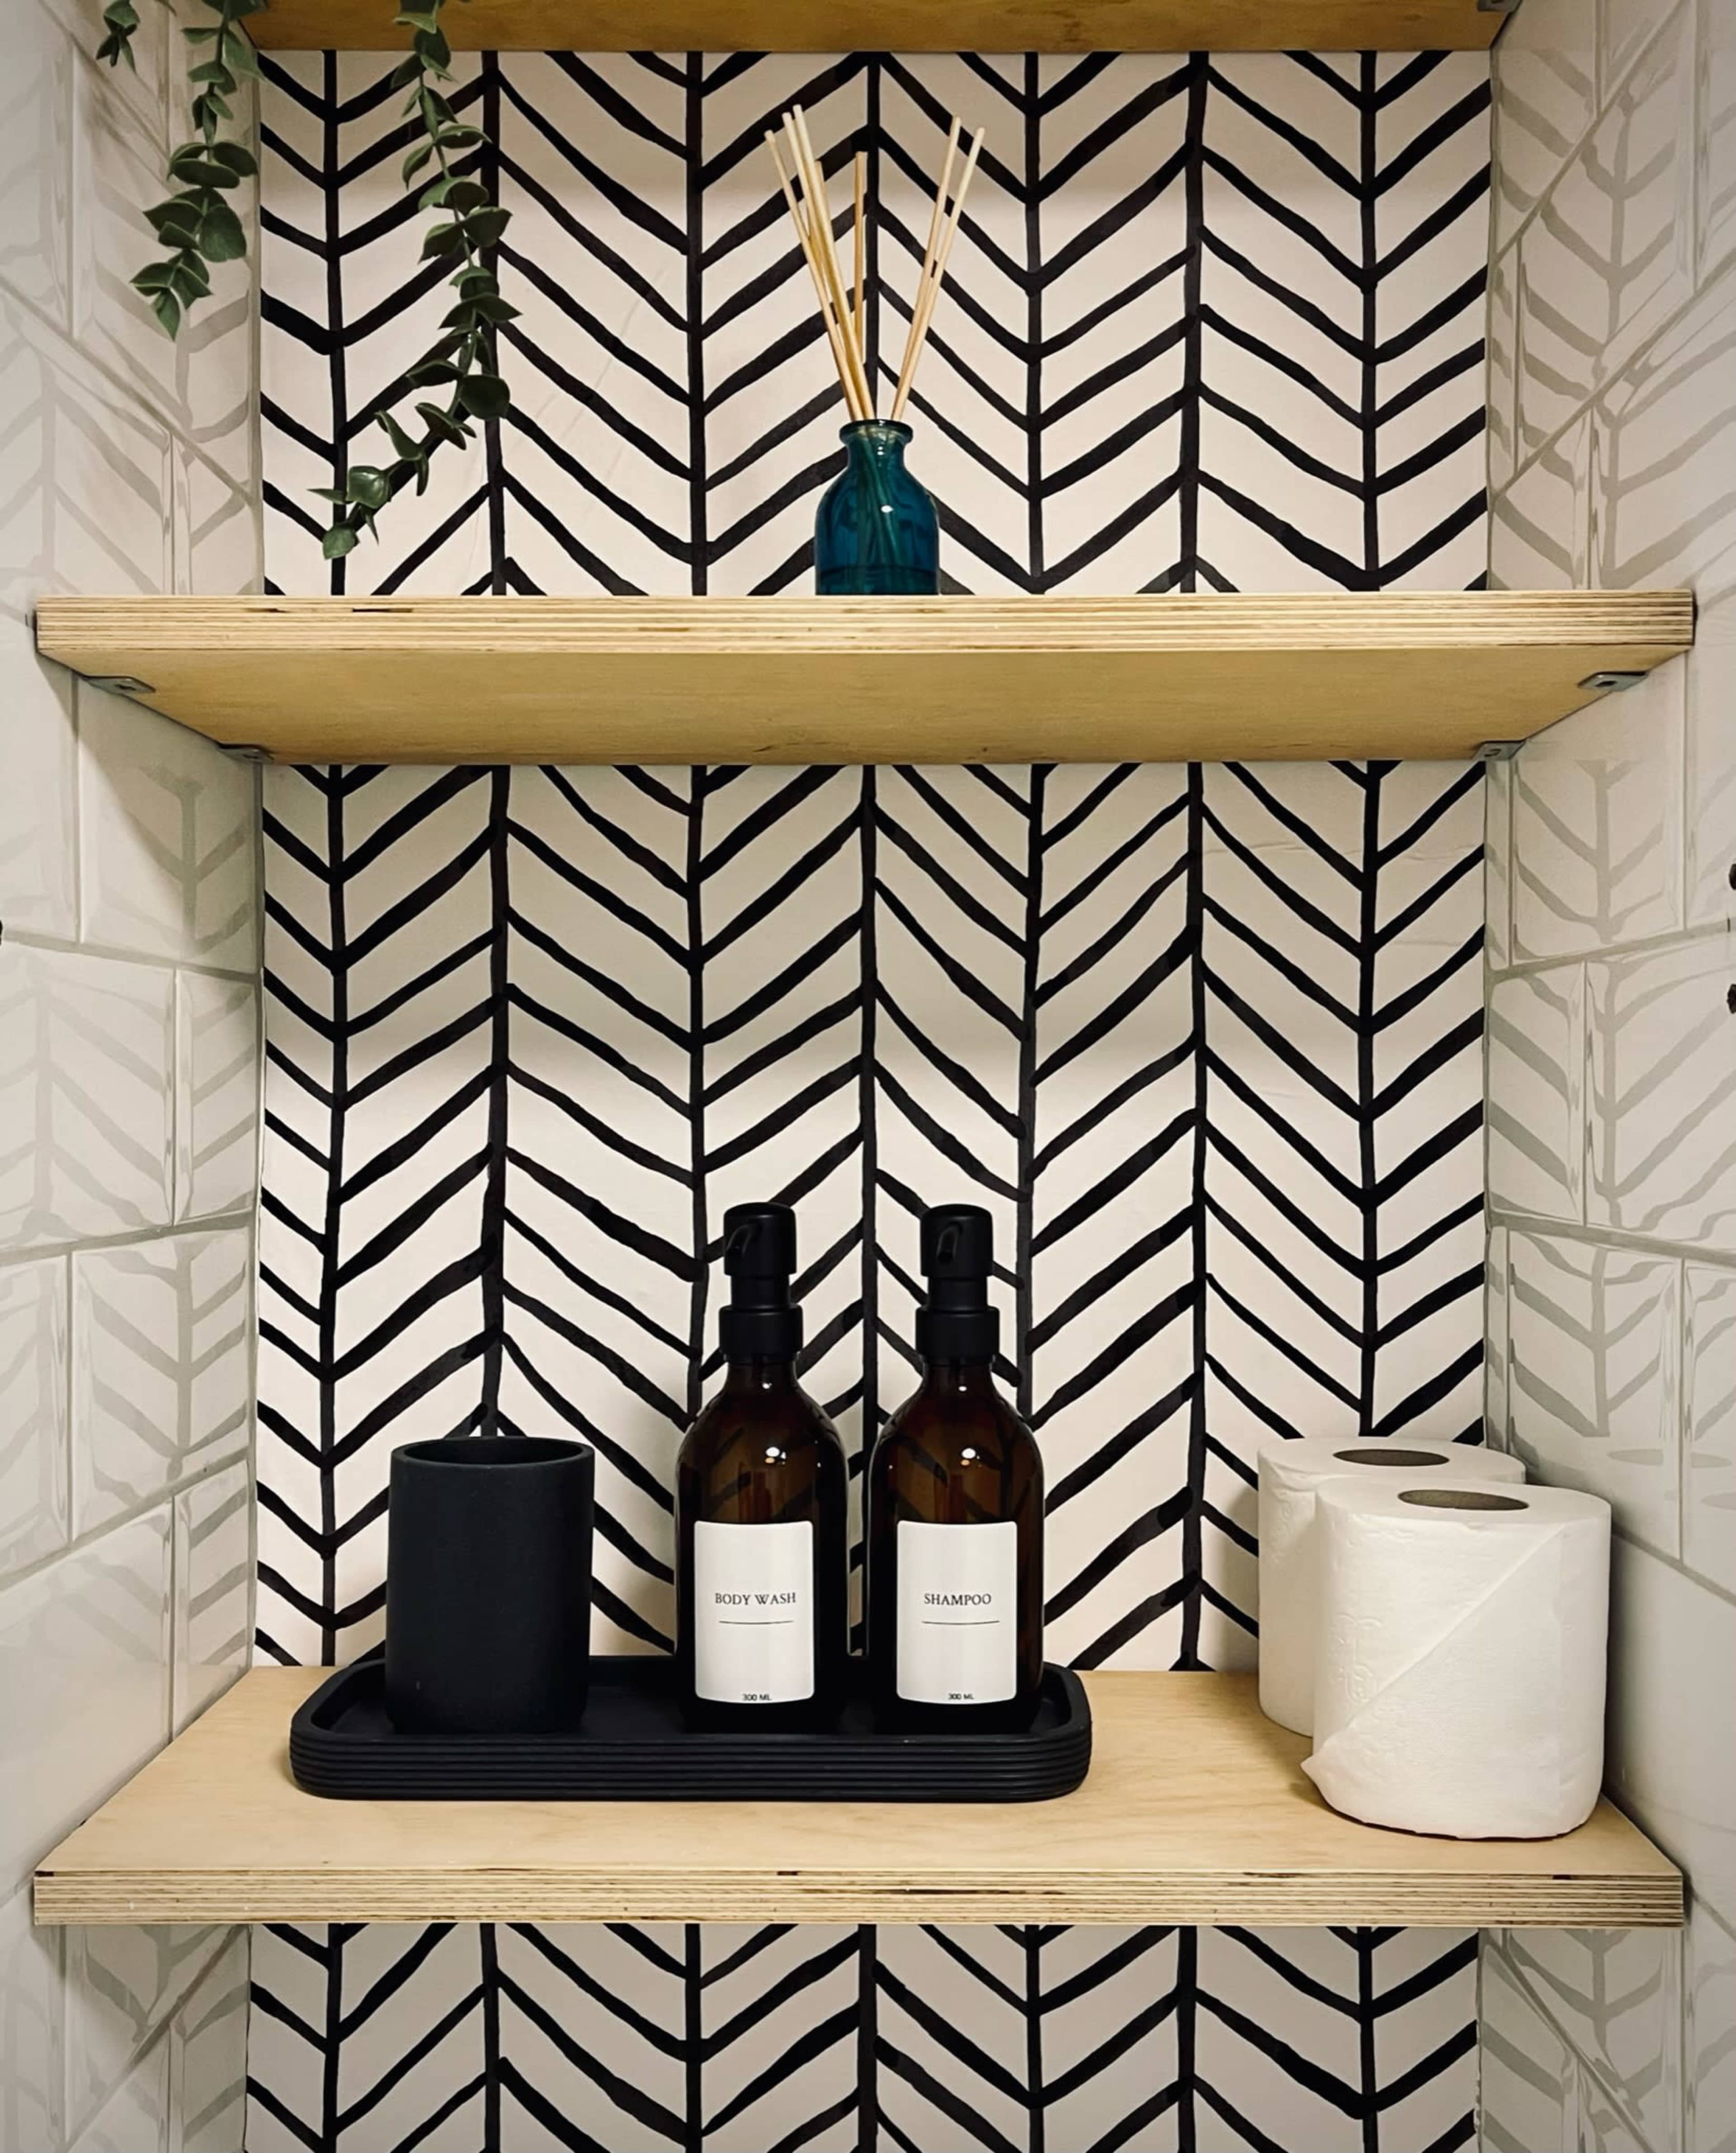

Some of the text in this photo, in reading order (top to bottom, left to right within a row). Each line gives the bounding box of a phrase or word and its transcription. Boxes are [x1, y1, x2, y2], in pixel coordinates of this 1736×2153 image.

[715, 1592, 796, 1605] BODY WASH
[924, 1593, 991, 1605] SHAMPOO
